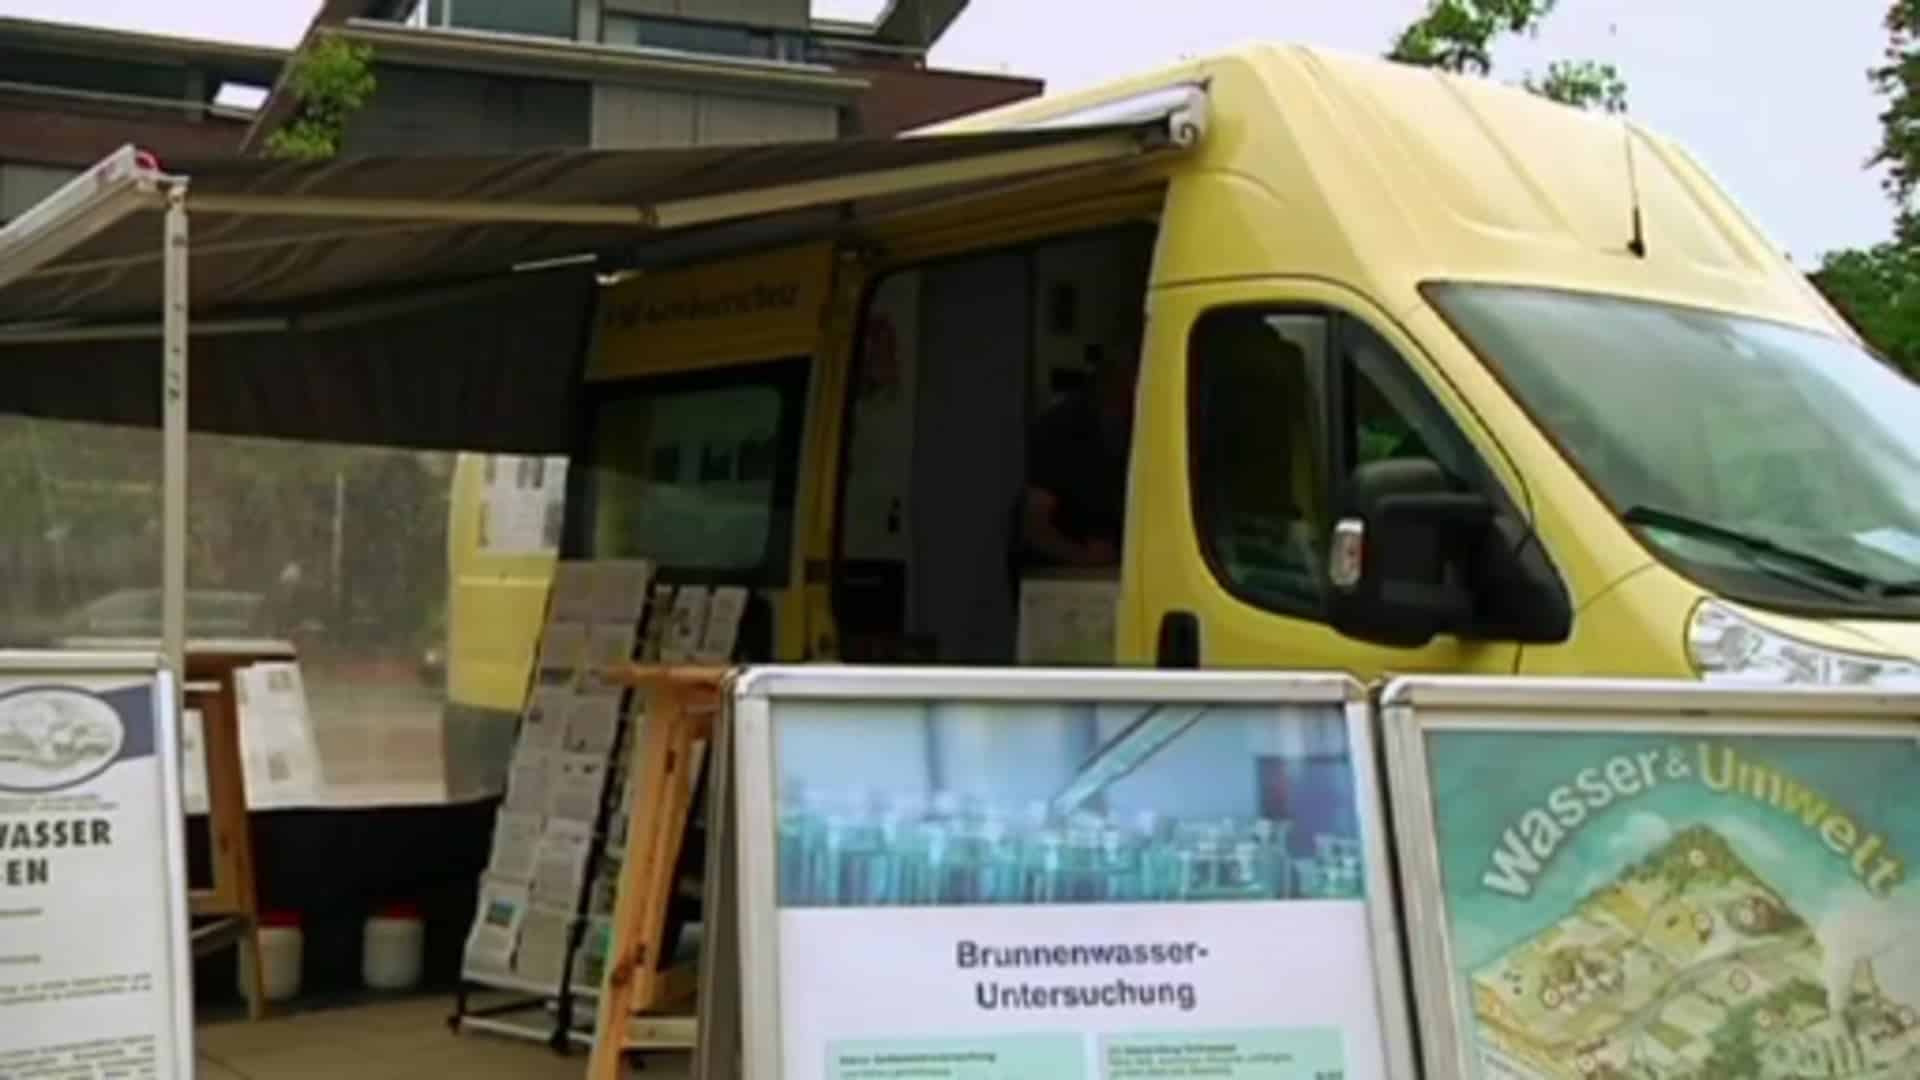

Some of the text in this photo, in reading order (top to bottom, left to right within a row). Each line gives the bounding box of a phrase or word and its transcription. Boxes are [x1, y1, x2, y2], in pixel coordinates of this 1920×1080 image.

[0, 817, 111, 851] ASSER
[1483, 742, 1904, 900] Wasser & Umwelt
[957, 940, 1208, 969] Brunnenwasser-
[976, 979, 1196, 1010] Untersuchung
